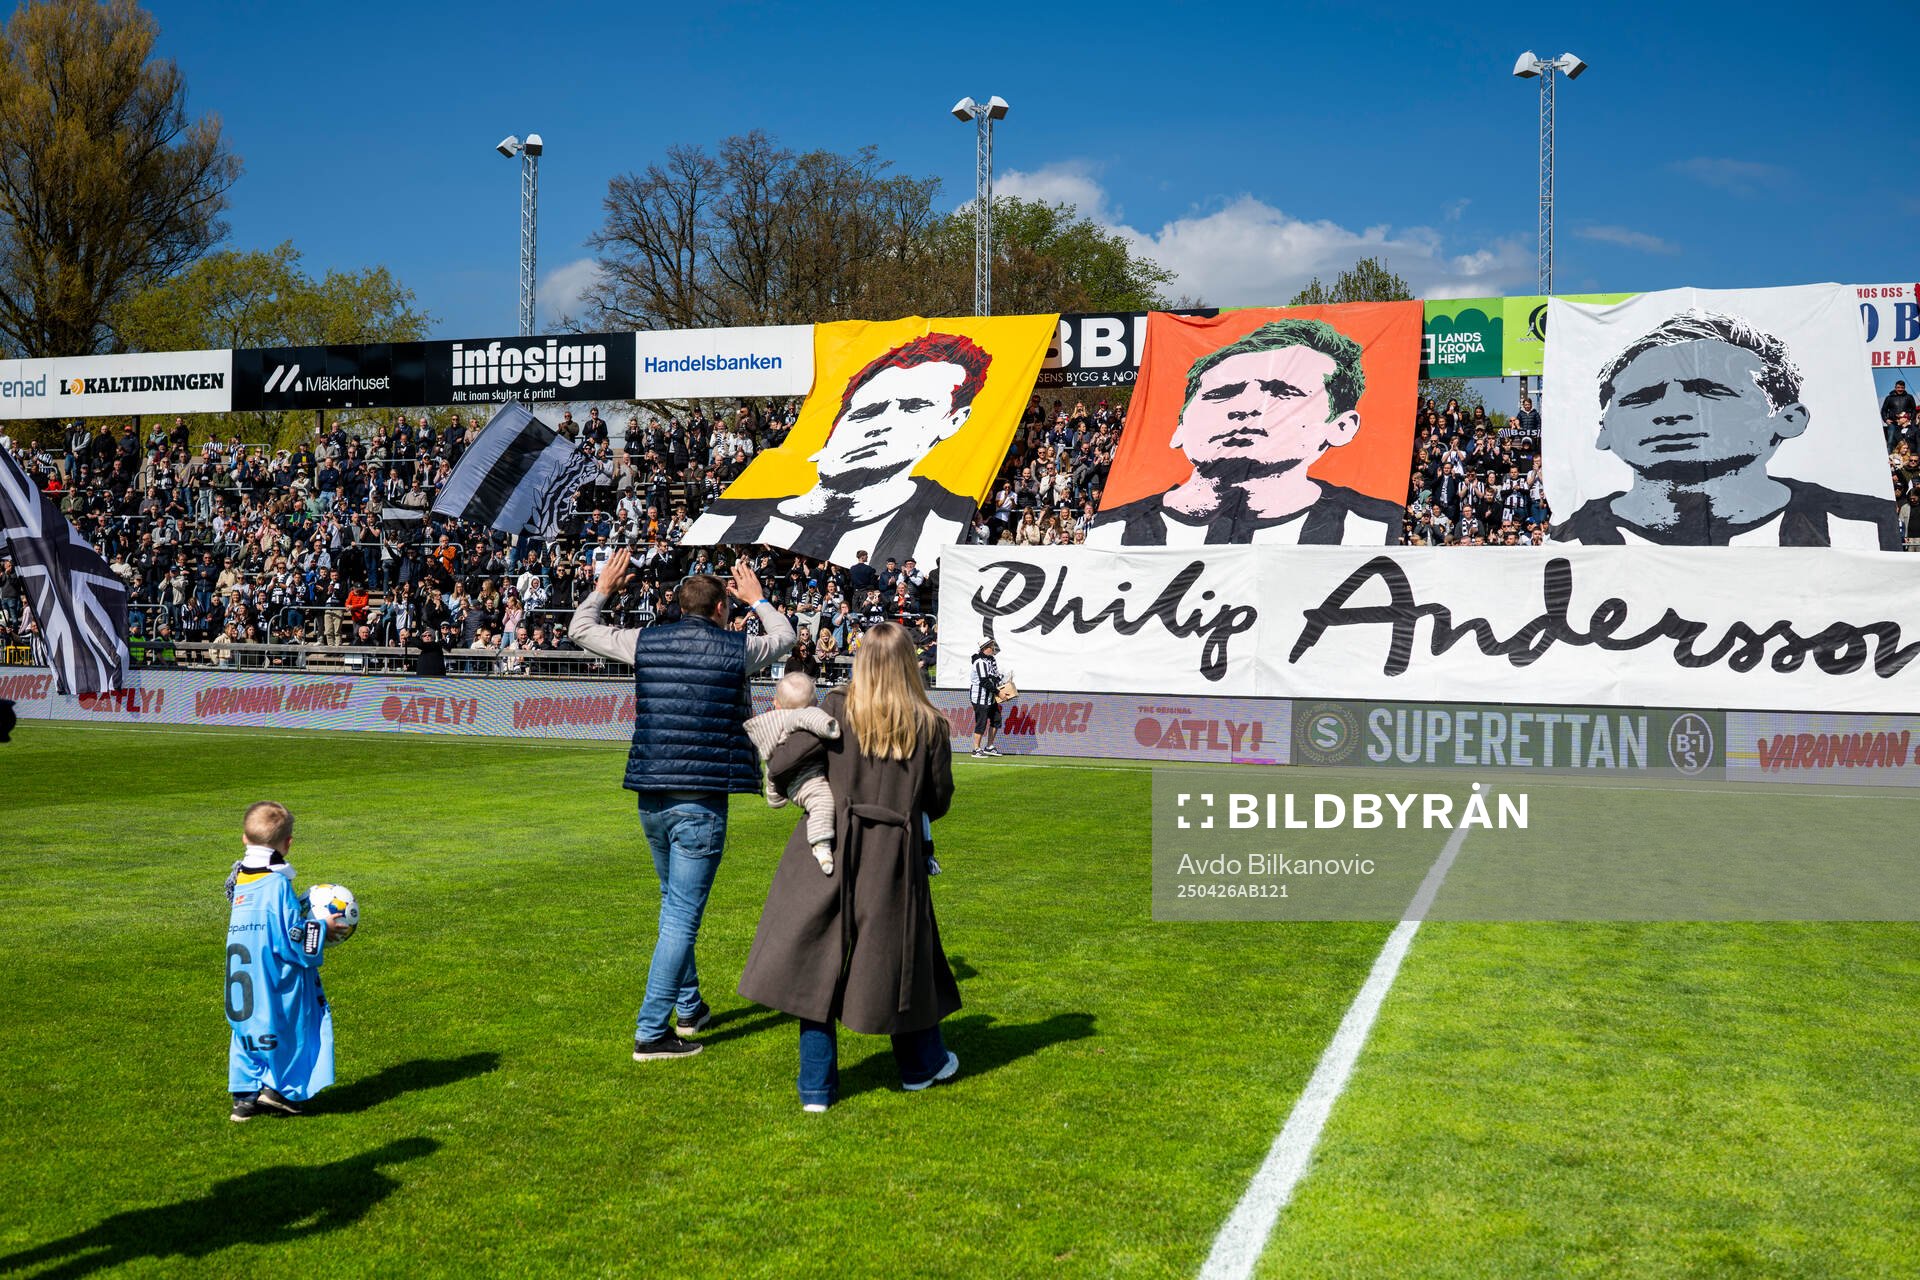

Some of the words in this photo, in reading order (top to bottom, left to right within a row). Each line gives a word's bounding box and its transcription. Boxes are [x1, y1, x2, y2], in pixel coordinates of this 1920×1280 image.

[1881, 288, 1902, 298] OSS
[1438, 332, 1481, 343] LANDS
[1438, 342, 1485, 354] KRONA
[1896, 347, 1917, 366] PÅ
[452, 339, 607, 388] infosign
[644, 353, 783, 374] Handelsbanken
[1438, 353, 1466, 364] HEM
[60, 372, 225, 396] LOKALTIDNINGEN
[306, 374, 391, 393] Mäklarhuset
[1066, 371, 1099, 382] BYGG
[1102, 371, 1111, 381] &
[452, 390, 467, 402] Allt
[469, 389, 490, 401] inom
[491, 389, 522, 403] skyltar
[523, 388, 530, 399] &
[531, 387, 556, 401] print!
[971, 559, 1258, 682] Philip
[381, 695, 478, 725] OATLY!
[1004, 701, 1094, 736] HAVRE!
[1138, 706, 1154, 714] THE
[1134, 717, 1264, 753] OATLY!
[1367, 708, 1648, 770] SUPERETTAN
[225, 943, 255, 1023] 6
